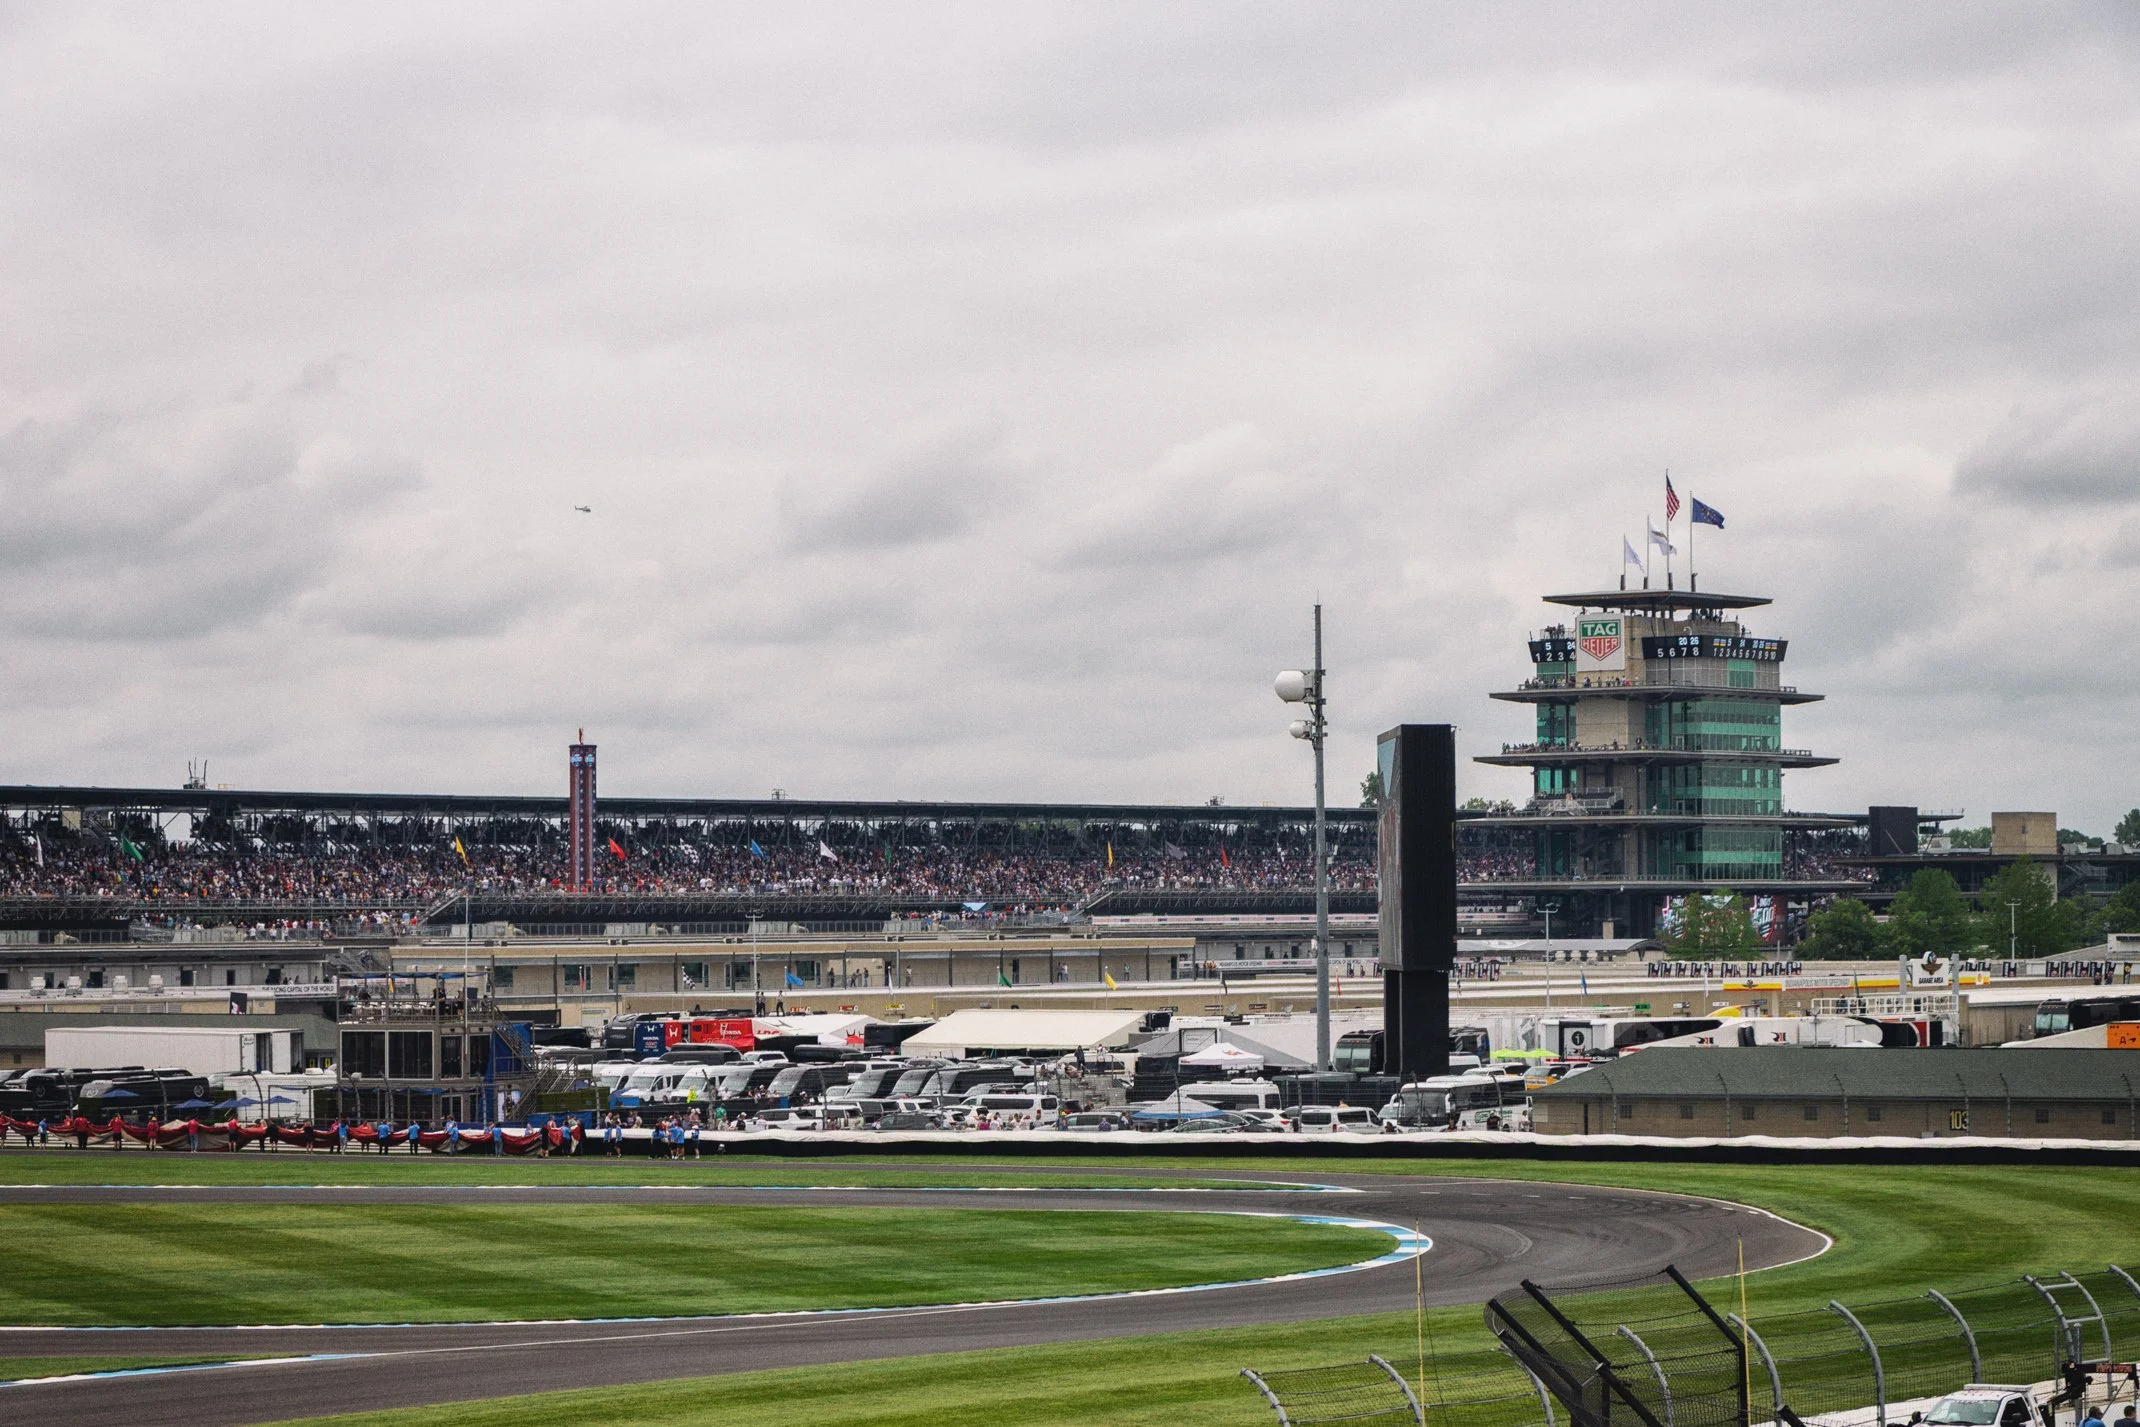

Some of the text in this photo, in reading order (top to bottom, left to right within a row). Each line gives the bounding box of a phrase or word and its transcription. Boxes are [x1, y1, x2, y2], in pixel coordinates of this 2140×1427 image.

[1583, 623, 1616, 636] TAG
[1545, 642, 1552, 650] 5
[1678, 636, 1699, 646] 20 26
[1582, 638, 1618, 657] HEUER
[1657, 646, 1699, 658] 5 6 7 8
[1536, 652, 1576, 662] 1 2 3 4
[1719, 648, 1724, 657] 2
[1726, 648, 1731, 657] 3
[1732, 649, 1737, 658] 4
[1738, 649, 1743, 658] 5
[1745, 650, 1750, 658] 6
[1752, 650, 1756, 659] 7
[1758, 650, 1763, 660] 8
[1764, 651, 1769, 660] 9
[1950, 1110, 1968, 1130] 103
